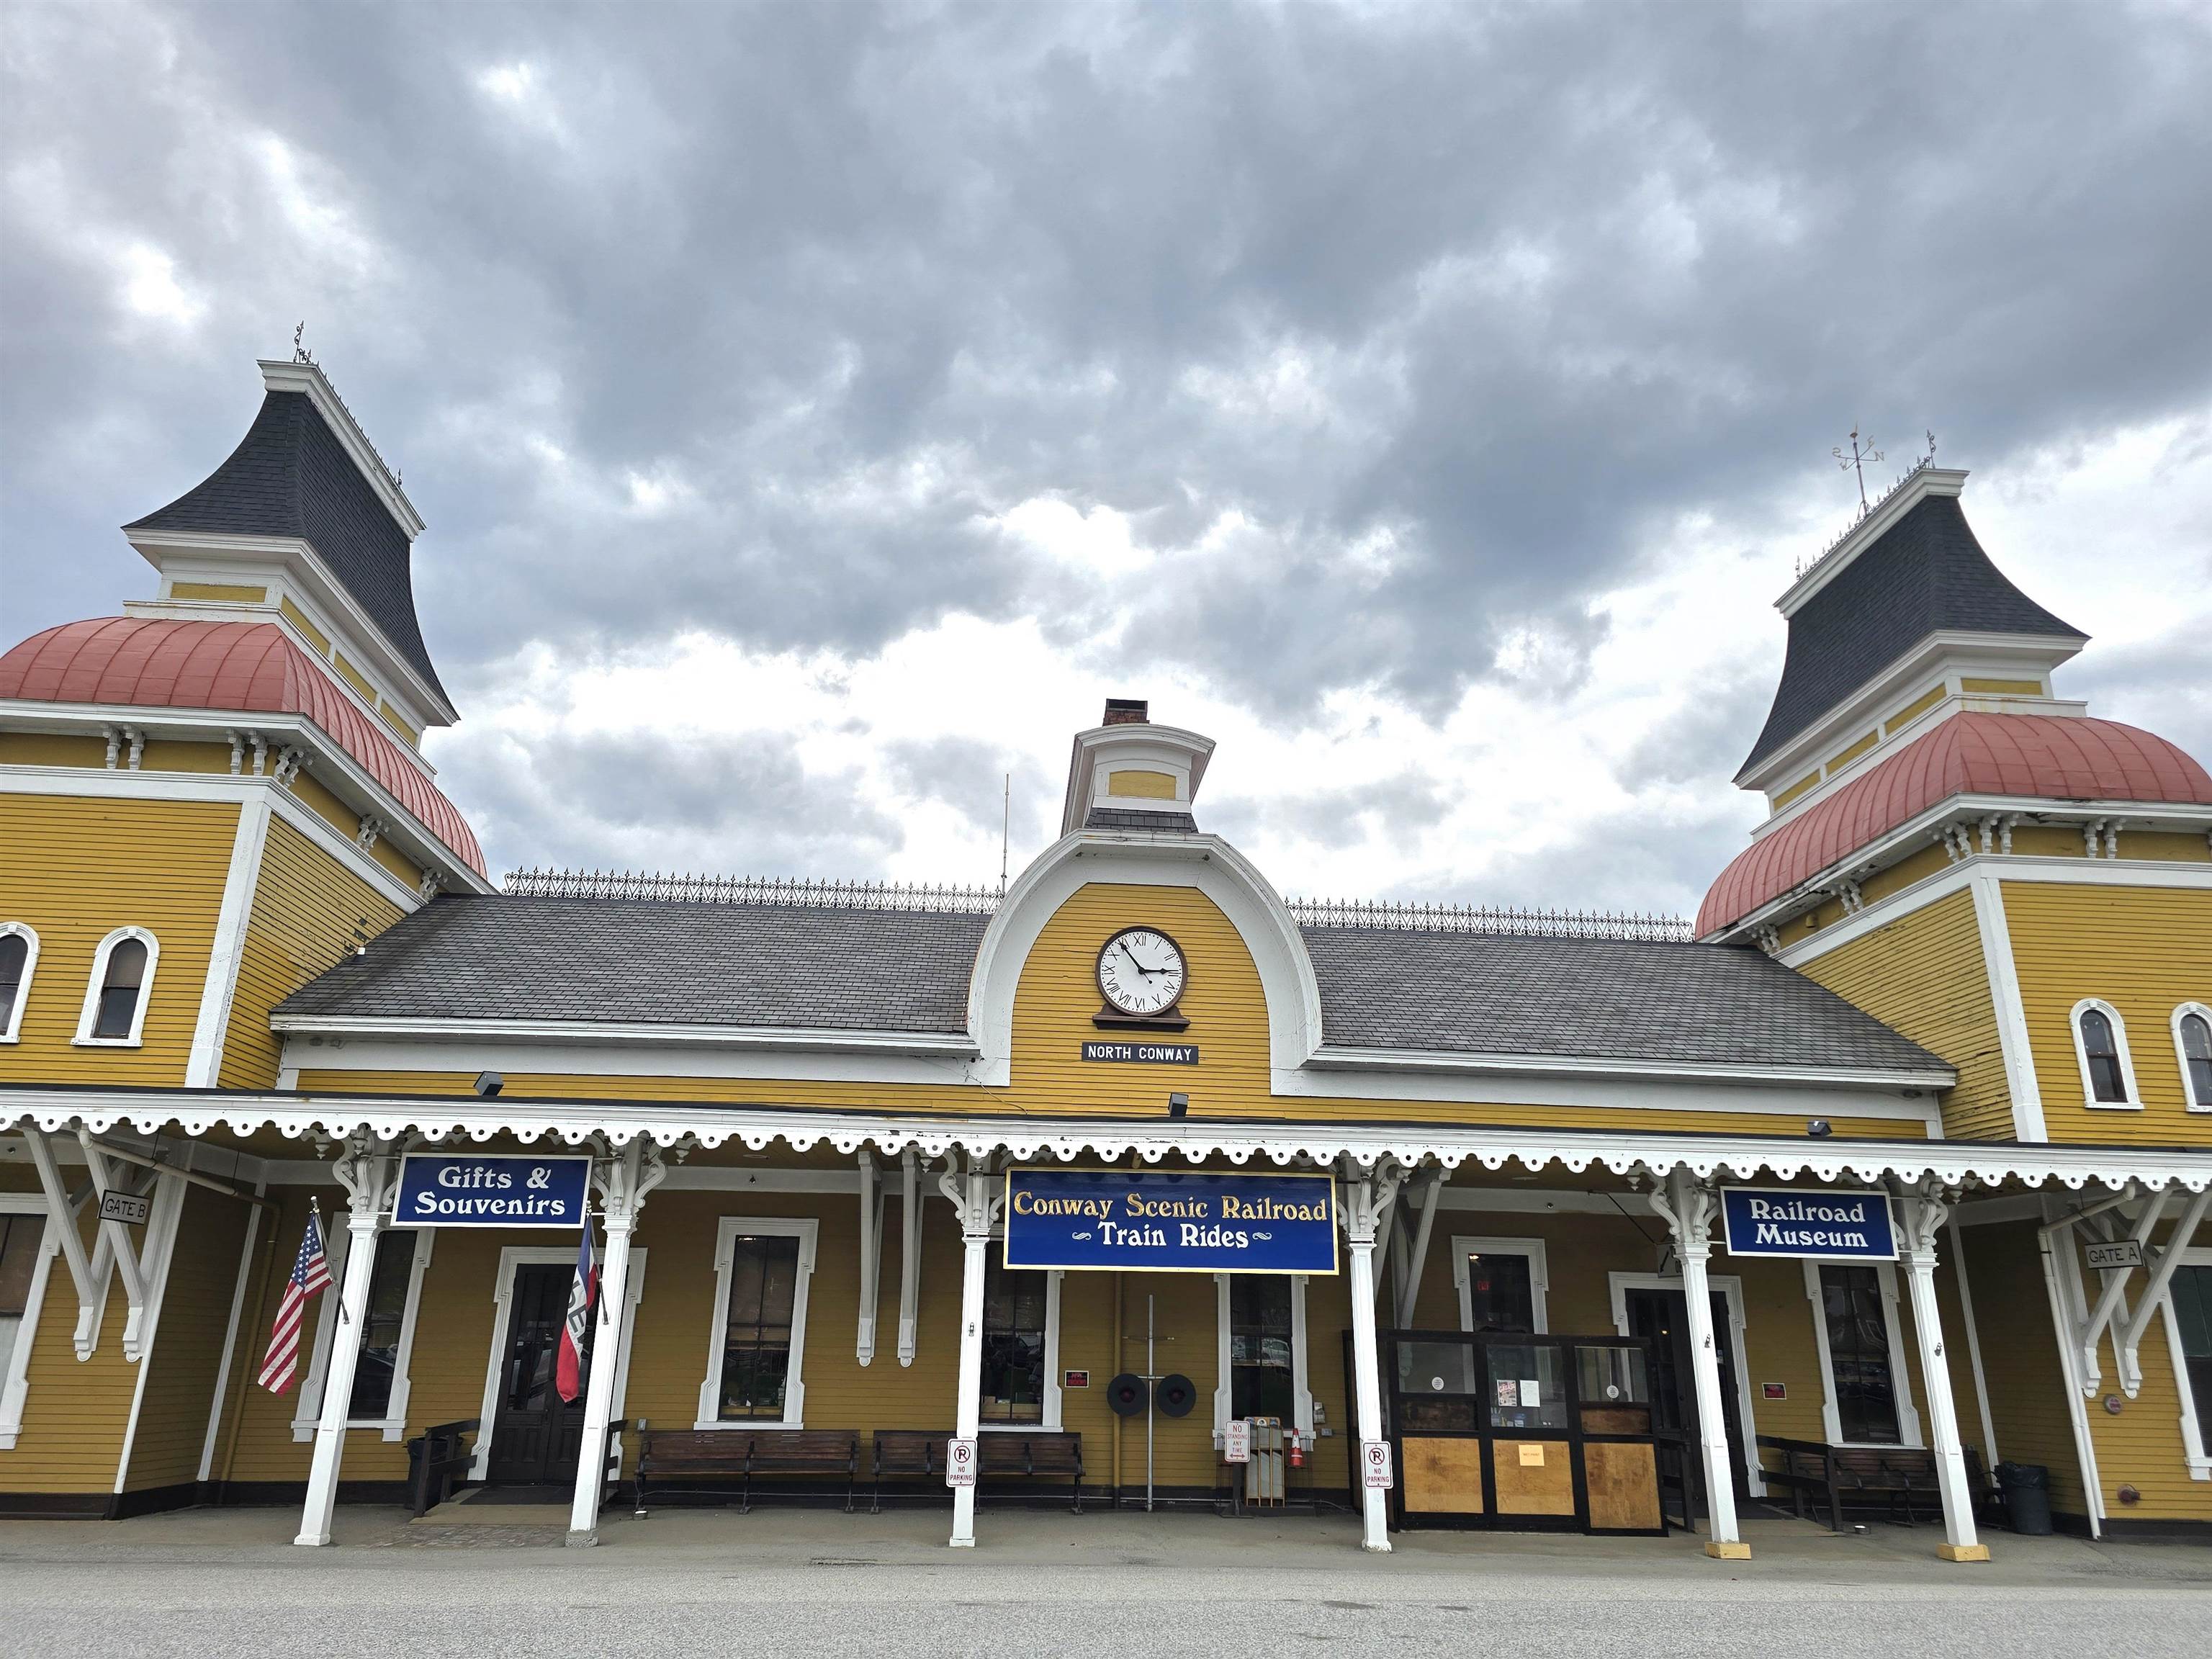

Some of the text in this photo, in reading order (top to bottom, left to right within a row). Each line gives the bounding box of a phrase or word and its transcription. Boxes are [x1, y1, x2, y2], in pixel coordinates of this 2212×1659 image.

[1133, 935, 1146, 947] XII
[1107, 949, 1120, 961] X
[1164, 953, 1175, 961] II
[1106, 977, 1121, 994] VIII
[1163, 980, 1176, 994] IV
[1118, 990, 1132, 1006] VII
[1134, 997, 1146, 1009] VI
[1151, 993, 1162, 1007] V
[1088, 1045, 1192, 1061] NORTH CONWAY
[438, 1166, 552, 1190] Gifts &
[105, 1198, 146, 1218] GATE B
[414, 1190, 565, 1216] Souvenirs
[1014, 1191, 1328, 1221] Conway Scenic Railroad
[1749, 1198, 1866, 1223] Railroad
[1097, 1220, 1249, 1249] Train Rides
[1755, 1223, 1869, 1247] Museum
[2089, 1246, 2139, 1263] GATE A
[1233, 1424, 1242, 1433] NO
